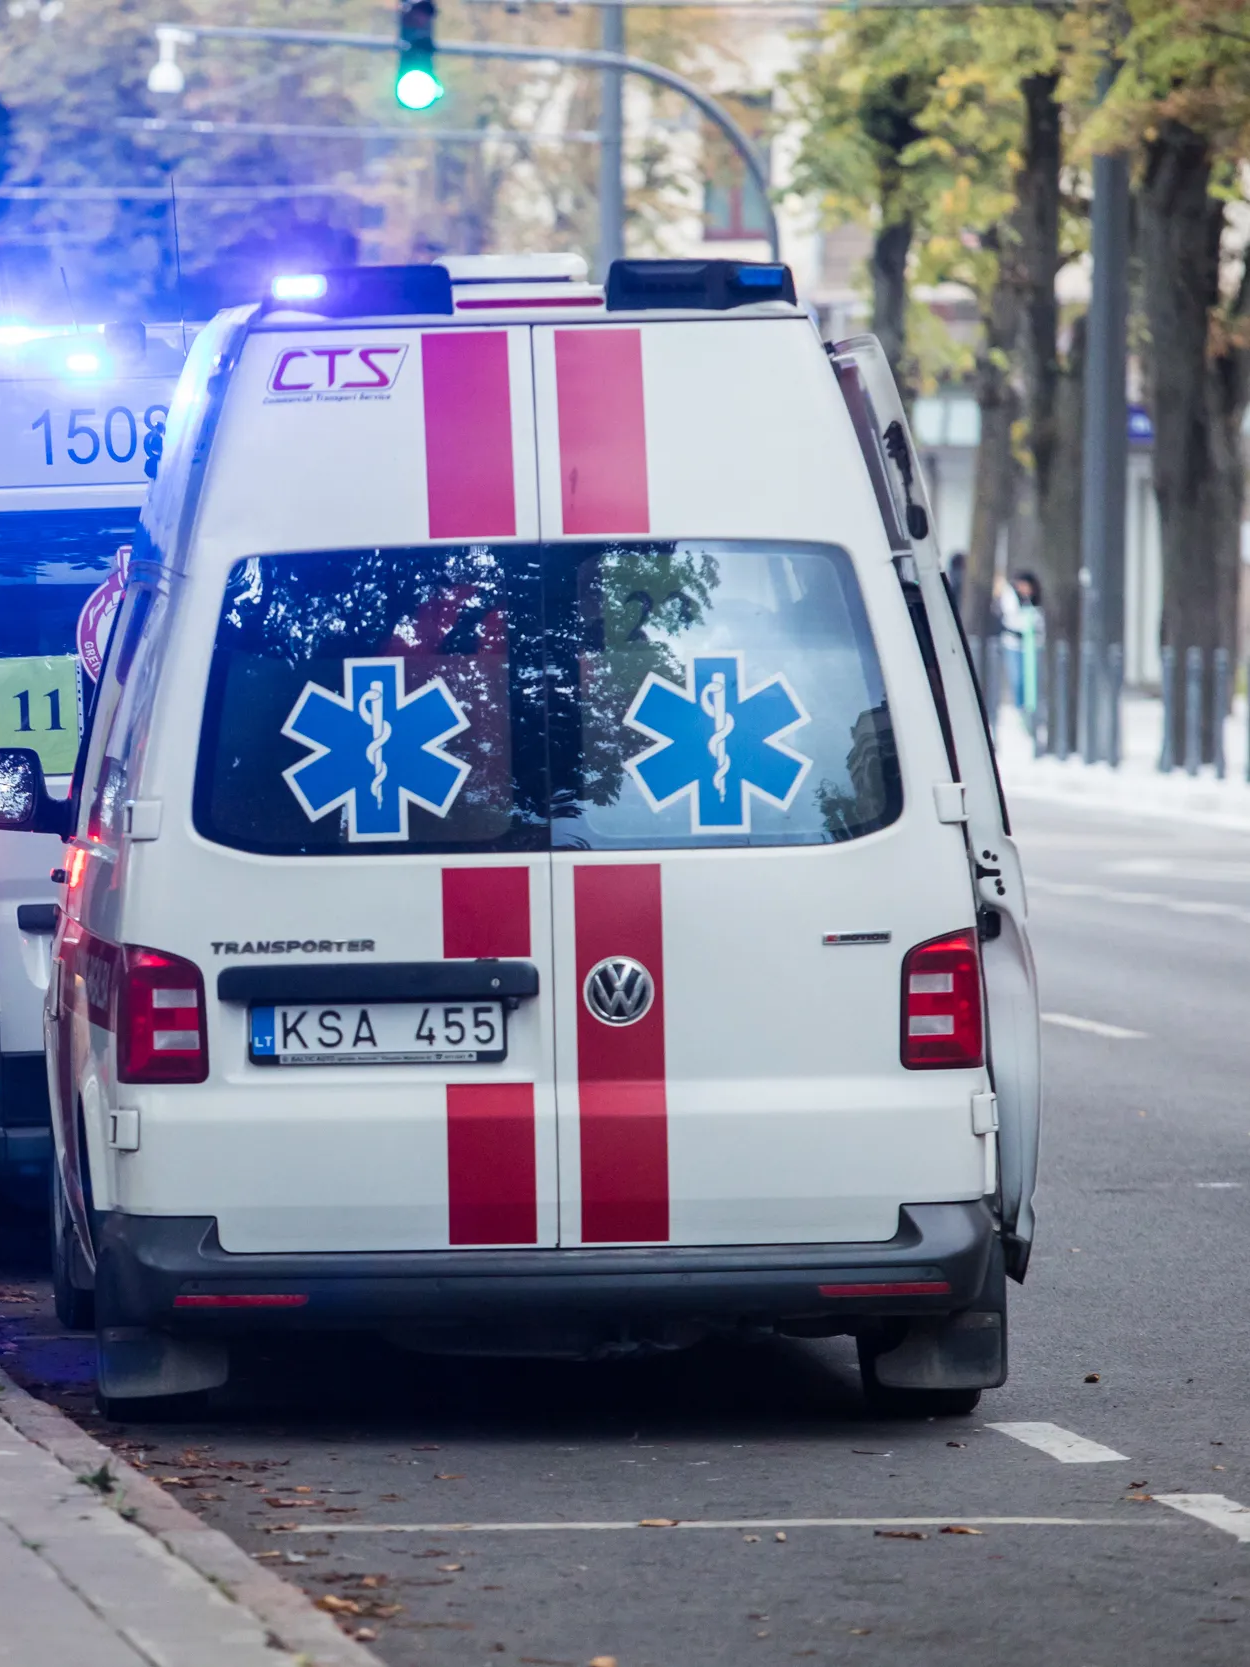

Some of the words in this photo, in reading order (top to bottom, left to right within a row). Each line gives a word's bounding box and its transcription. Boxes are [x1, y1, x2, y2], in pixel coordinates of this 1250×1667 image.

[272, 348, 402, 391] CTS
[31, 404, 169, 465] 1508
[12, 688, 67, 732] 11
[210, 939, 376, 955] TRANSPORTER
[254, 1036, 273, 1048] LT
[281, 1008, 377, 1049] KSA
[415, 1006, 495, 1046] 455
